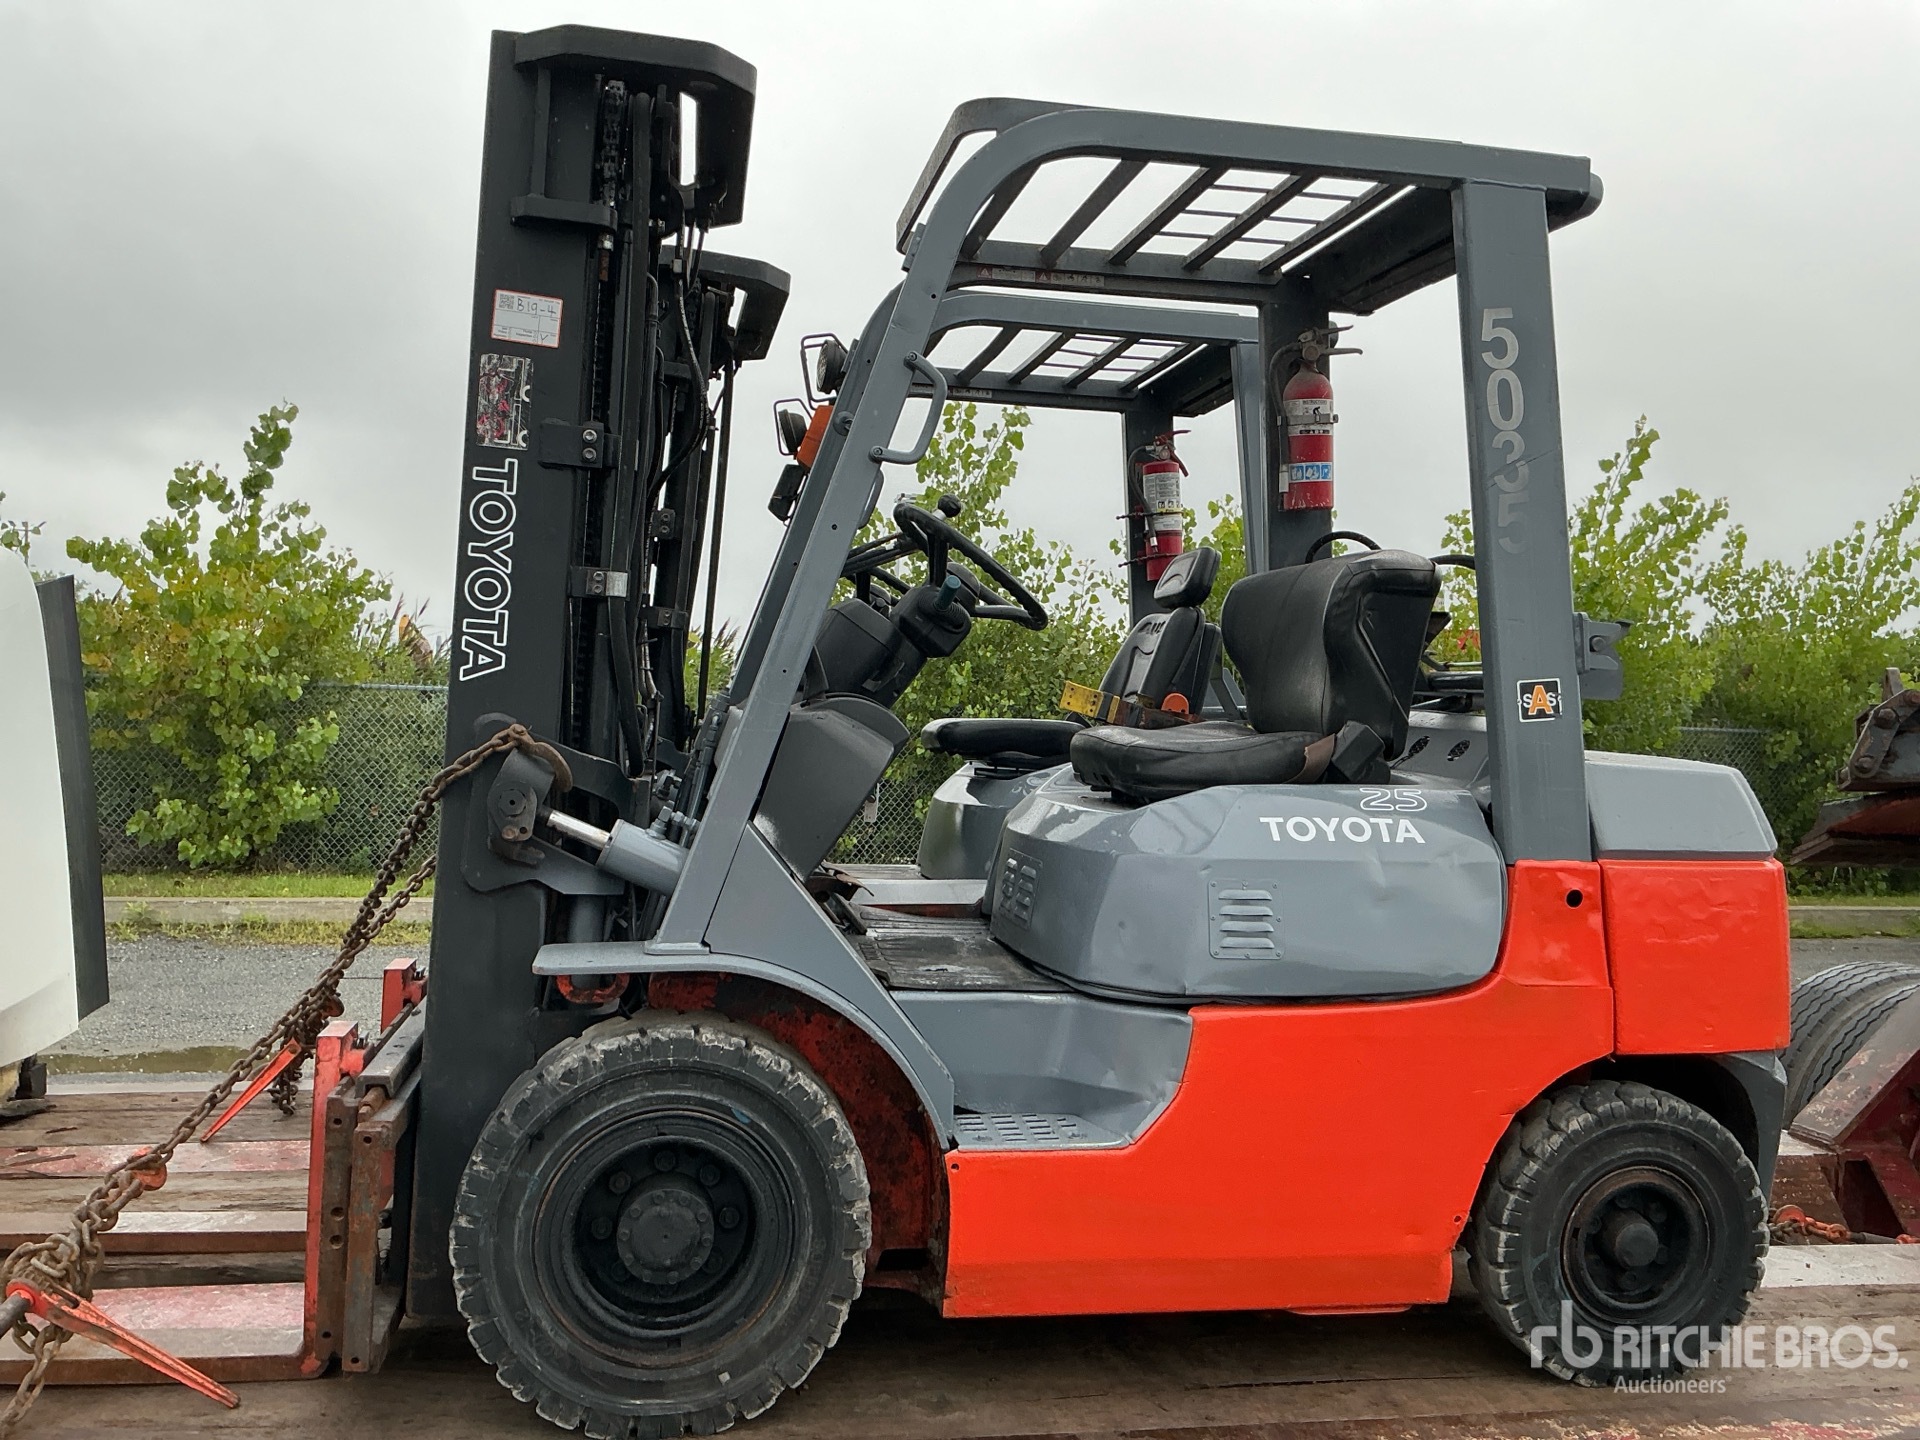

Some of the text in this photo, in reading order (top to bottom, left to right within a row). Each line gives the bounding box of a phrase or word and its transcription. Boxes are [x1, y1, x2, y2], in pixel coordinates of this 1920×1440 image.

[459, 457, 519, 682] TOYOTA
[1522, 685, 1557, 715] SAS
[1359, 787, 1428, 812] 25
[1259, 816, 1426, 844] TOYOTA
